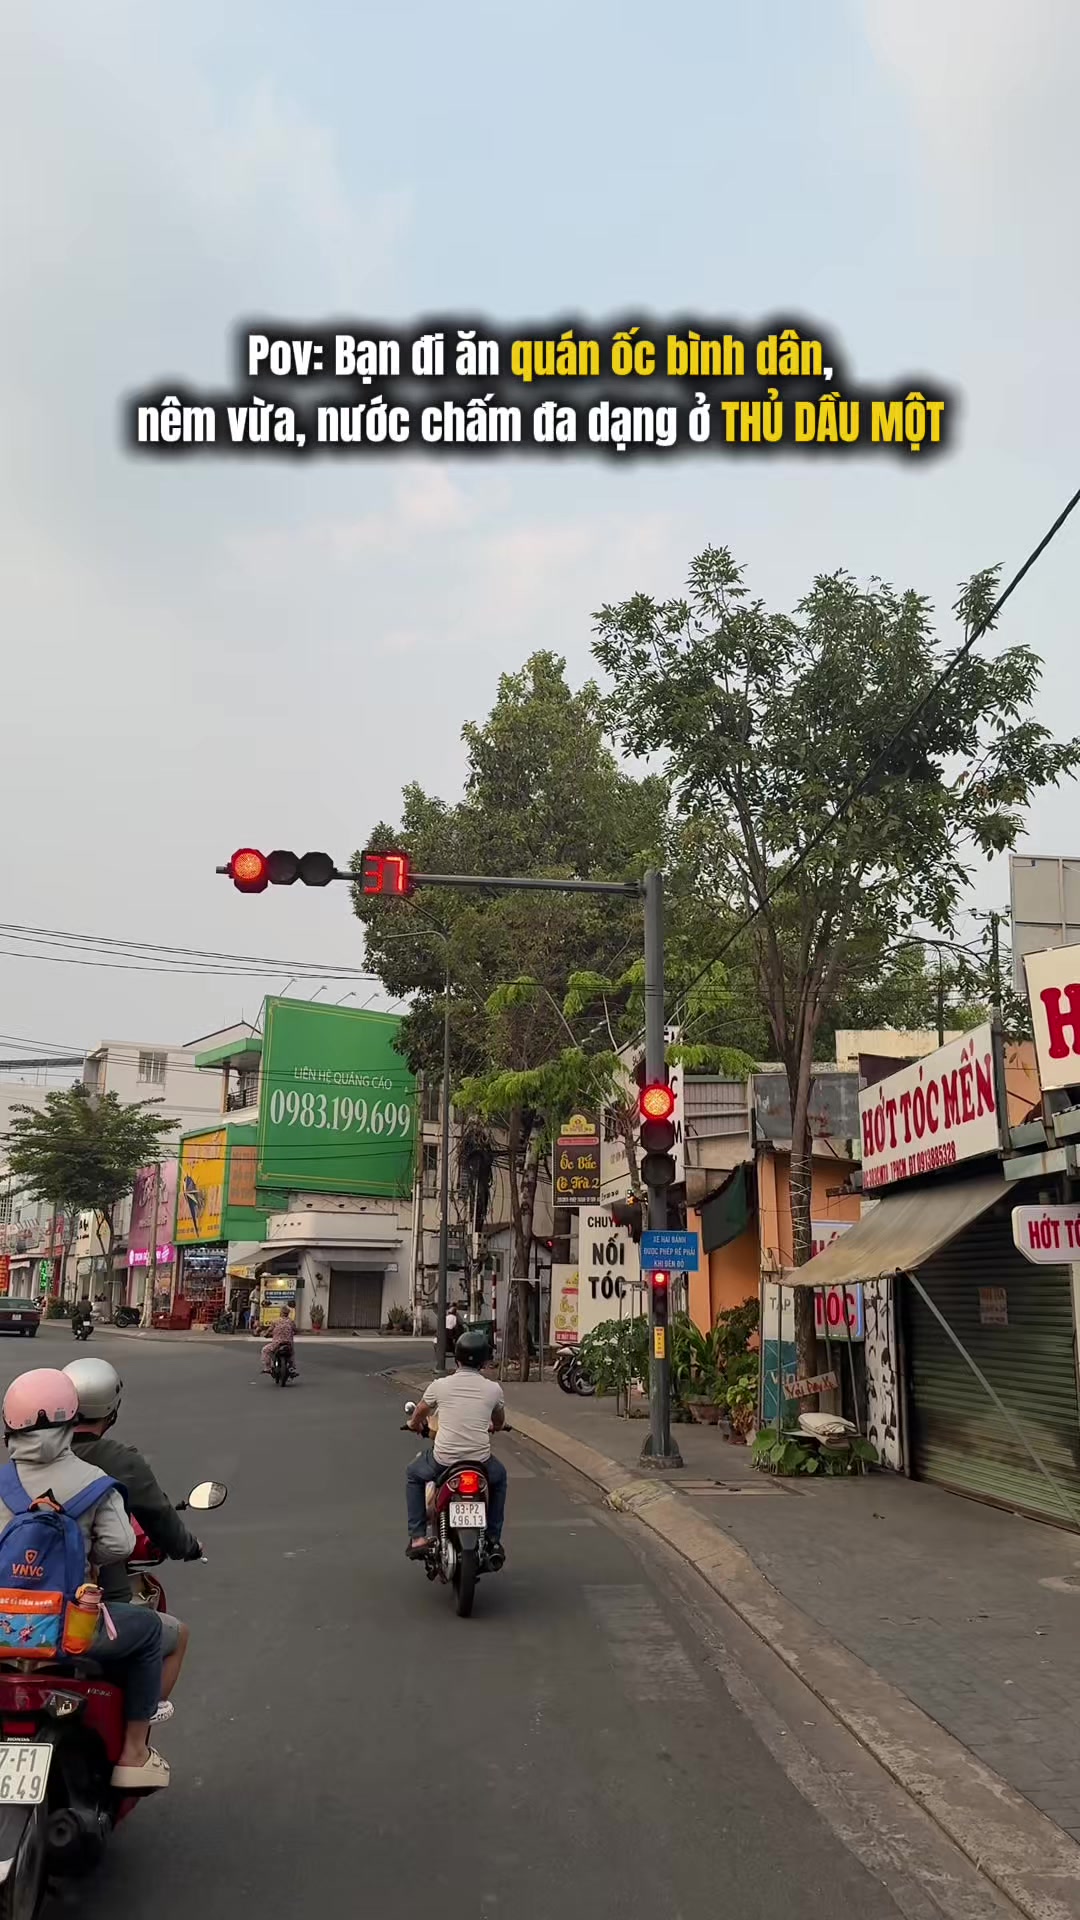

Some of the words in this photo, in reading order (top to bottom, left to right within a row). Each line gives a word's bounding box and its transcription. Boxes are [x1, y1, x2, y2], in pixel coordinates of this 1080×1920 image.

[364, 855, 405, 893] 37
[294, 1066, 317, 1081] LIÊN
[318, 1069, 332, 1083] HỆ
[333, 1071, 370, 1088] QUẢNG
[371, 1074, 393, 1091] CÁO
[861, 1085, 897, 1158] HỚT
[900, 1065, 939, 1143] TÓC
[941, 1038, 995, 1129] MẾN
[270, 1089, 411, 1138] 0983.199.699
[560, 1150, 575, 1170] Ốc
[577, 1153, 598, 1170] Bắc
[1028, 1213, 1060, 1249] HỚT
[592, 1233, 625, 1266] NỐI
[588, 1271, 627, 1299] TÓC
[813, 1286, 856, 1327] TÓC
[452, 1515, 483, 1526] 496.13
[455, 1503, 479, 1515] 83-P2
[12, 1563, 45, 1577] VNVC
